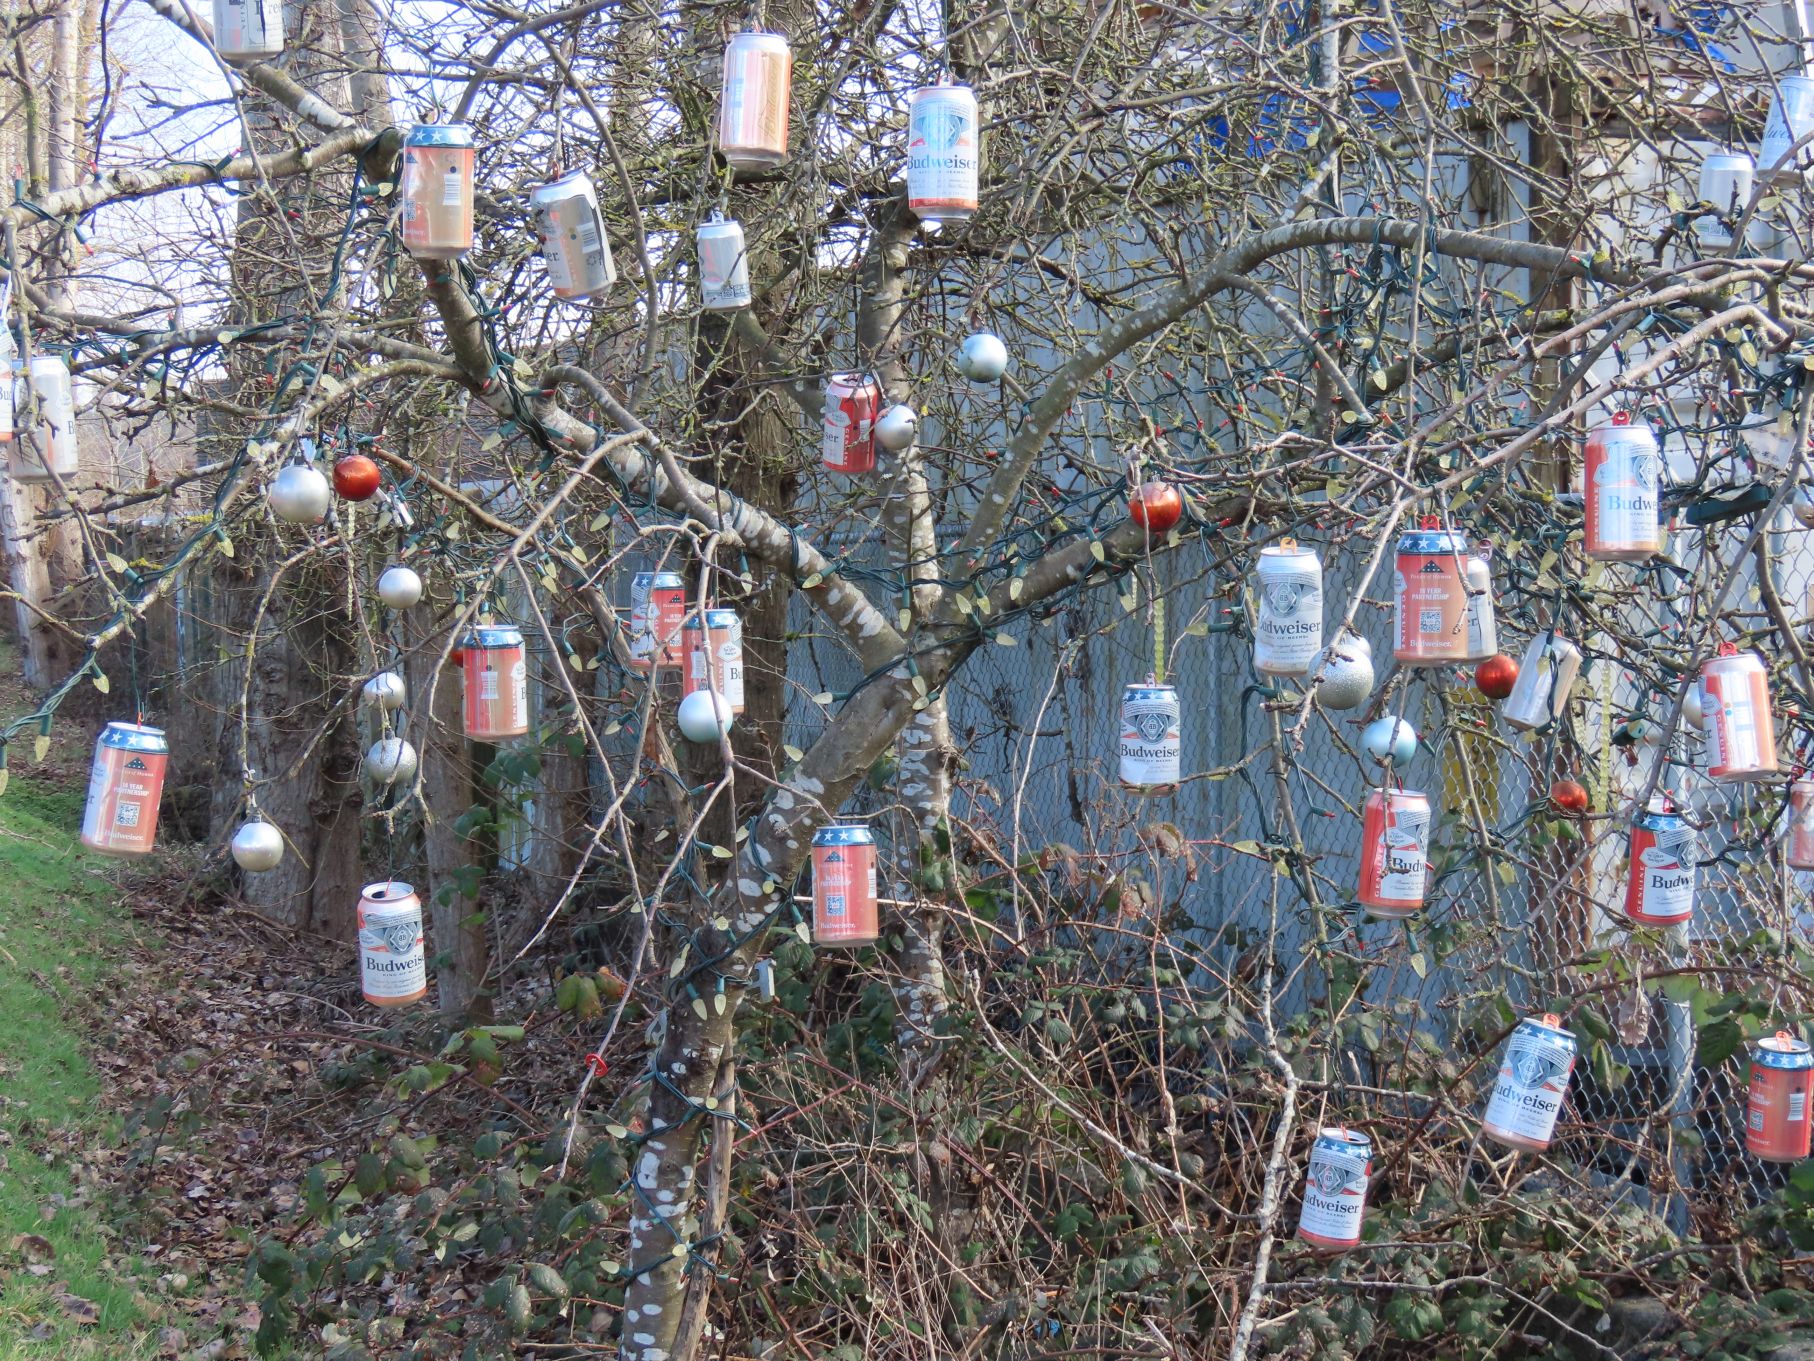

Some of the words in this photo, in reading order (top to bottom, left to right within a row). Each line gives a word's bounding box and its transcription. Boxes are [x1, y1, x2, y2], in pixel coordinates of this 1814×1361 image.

[907, 154, 977, 170] Budweiser
[1495, 1083, 1557, 1113] udweiser
[1304, 1193, 1360, 1214] udweiser
